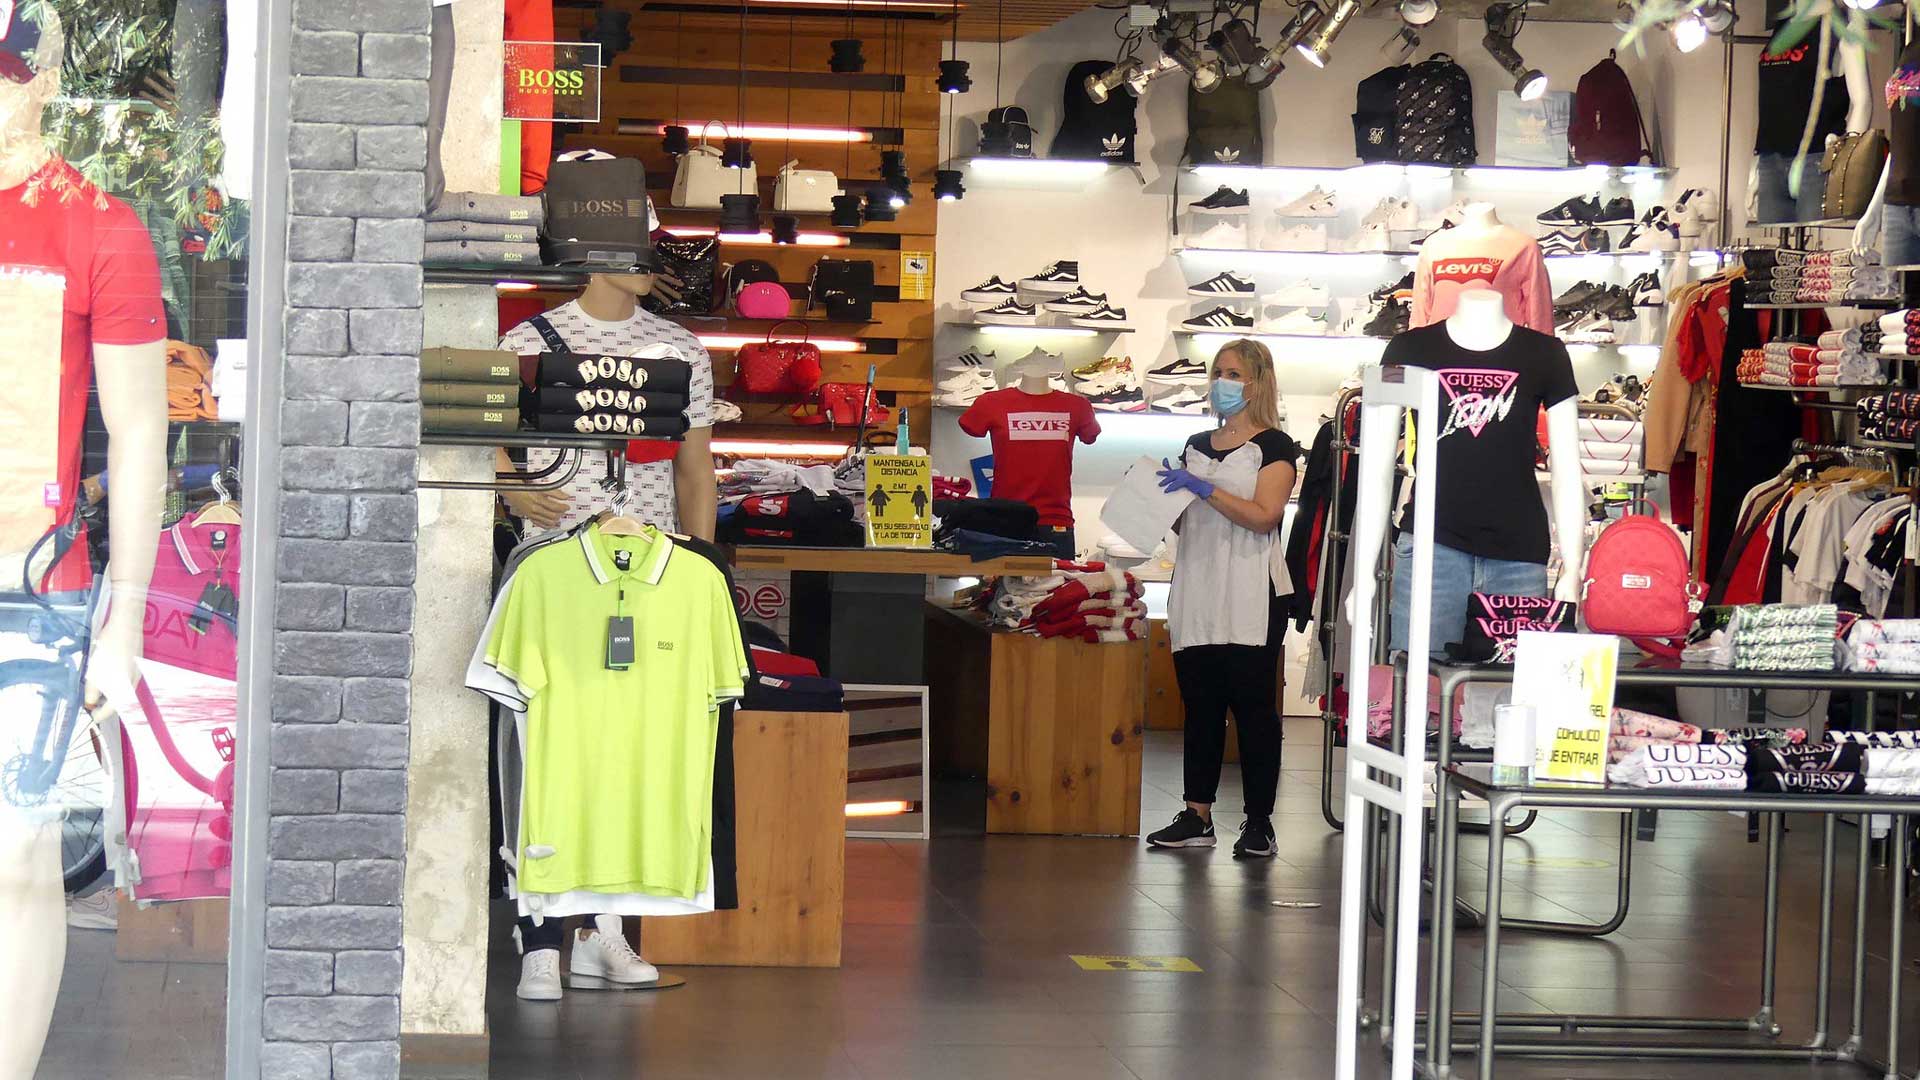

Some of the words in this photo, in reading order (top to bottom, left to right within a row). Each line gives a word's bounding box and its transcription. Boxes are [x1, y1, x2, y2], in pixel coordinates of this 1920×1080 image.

[519, 68, 584, 89] BOSS
[554, 88, 583, 96] BOSS
[510, 209, 529, 217] BOSS
[573, 199, 624, 214] BOSS
[577, 356, 649, 389] BOSS
[1446, 373, 1504, 389] GUESS
[486, 393, 505, 401] BOSS
[575, 388, 647, 413] BOSS
[484, 411, 503, 419] BOSS
[574, 413, 646, 436] BOSS
[873, 459, 914, 467] MANTENGA
[915, 459, 926, 467] LA
[880, 467, 918, 476] DISTANCIA
[1489, 594, 1552, 608] GUESS
[1560, 750, 1599, 766] ENTRAR
[1784, 771, 1841, 790] GUESS
